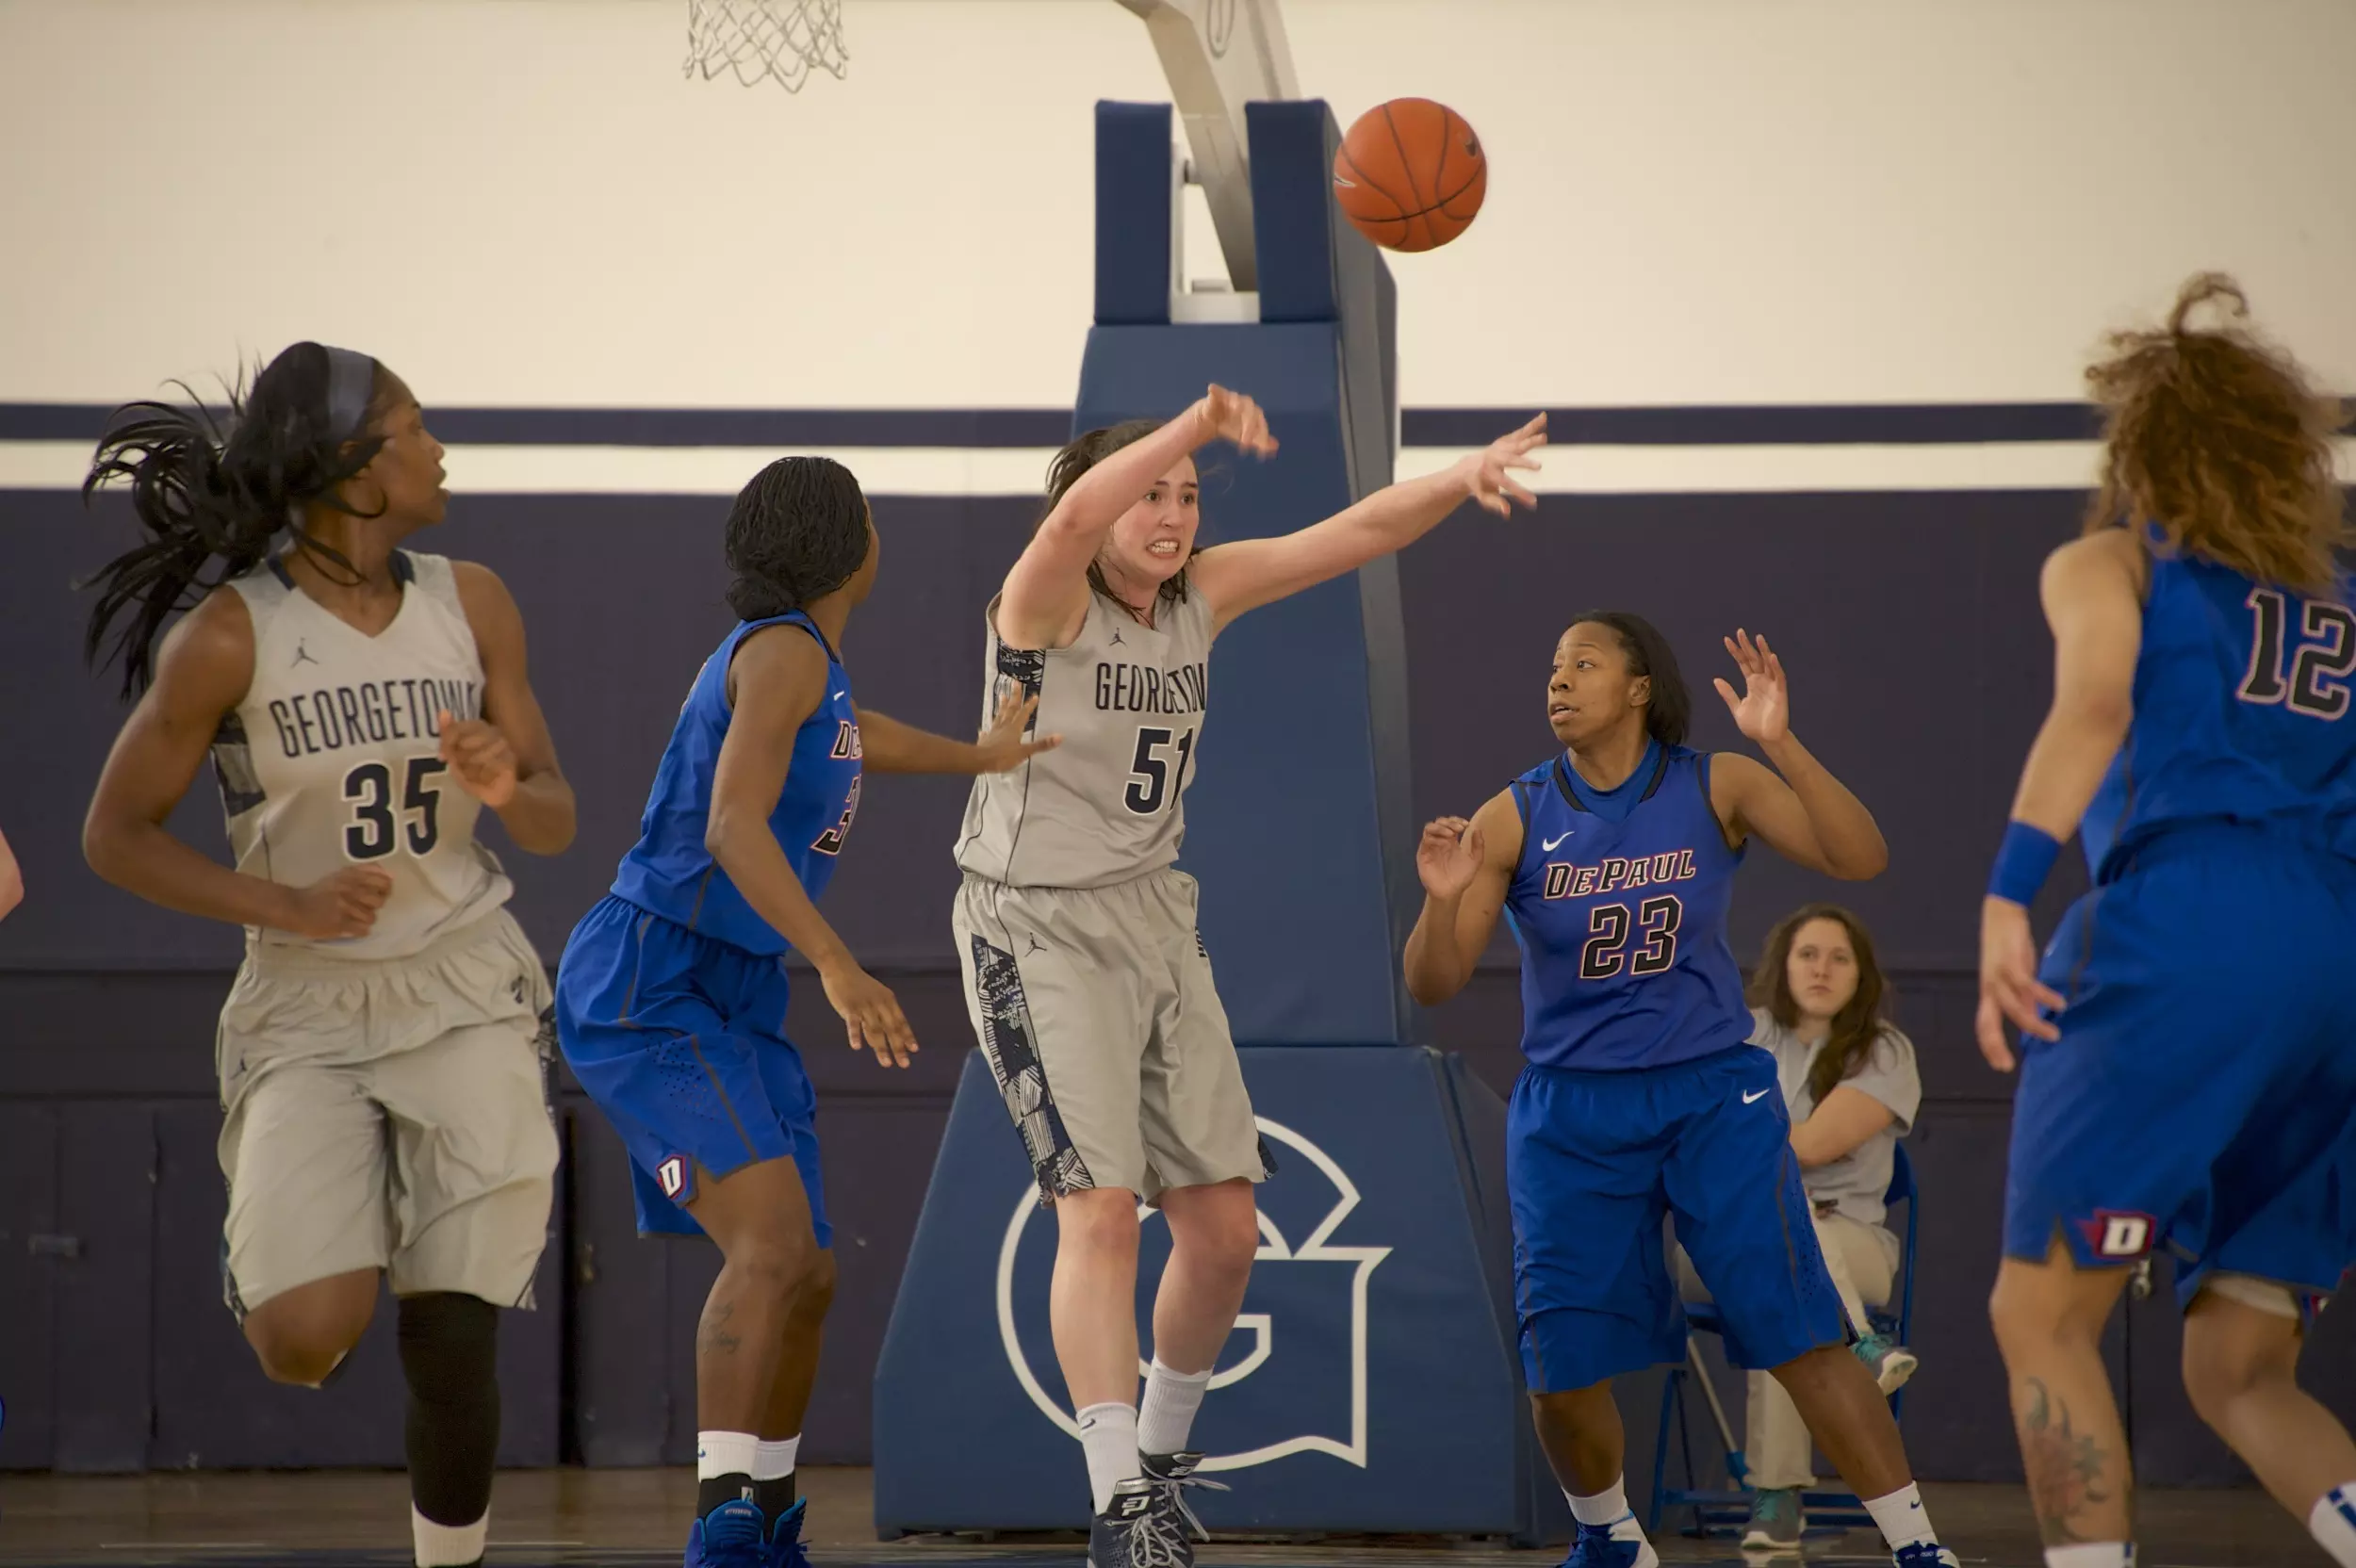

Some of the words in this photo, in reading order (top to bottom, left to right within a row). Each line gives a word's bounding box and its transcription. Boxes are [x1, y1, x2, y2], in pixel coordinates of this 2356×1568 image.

[2235, 586, 2356, 722] 12
[342, 755, 450, 862] 35
[1122, 726, 1195, 816] 51
[1579, 893, 1684, 980] 23
[658, 1157, 682, 1198] D
[2102, 1217, 2148, 1255] D
[996, 1114, 1394, 1472] G
